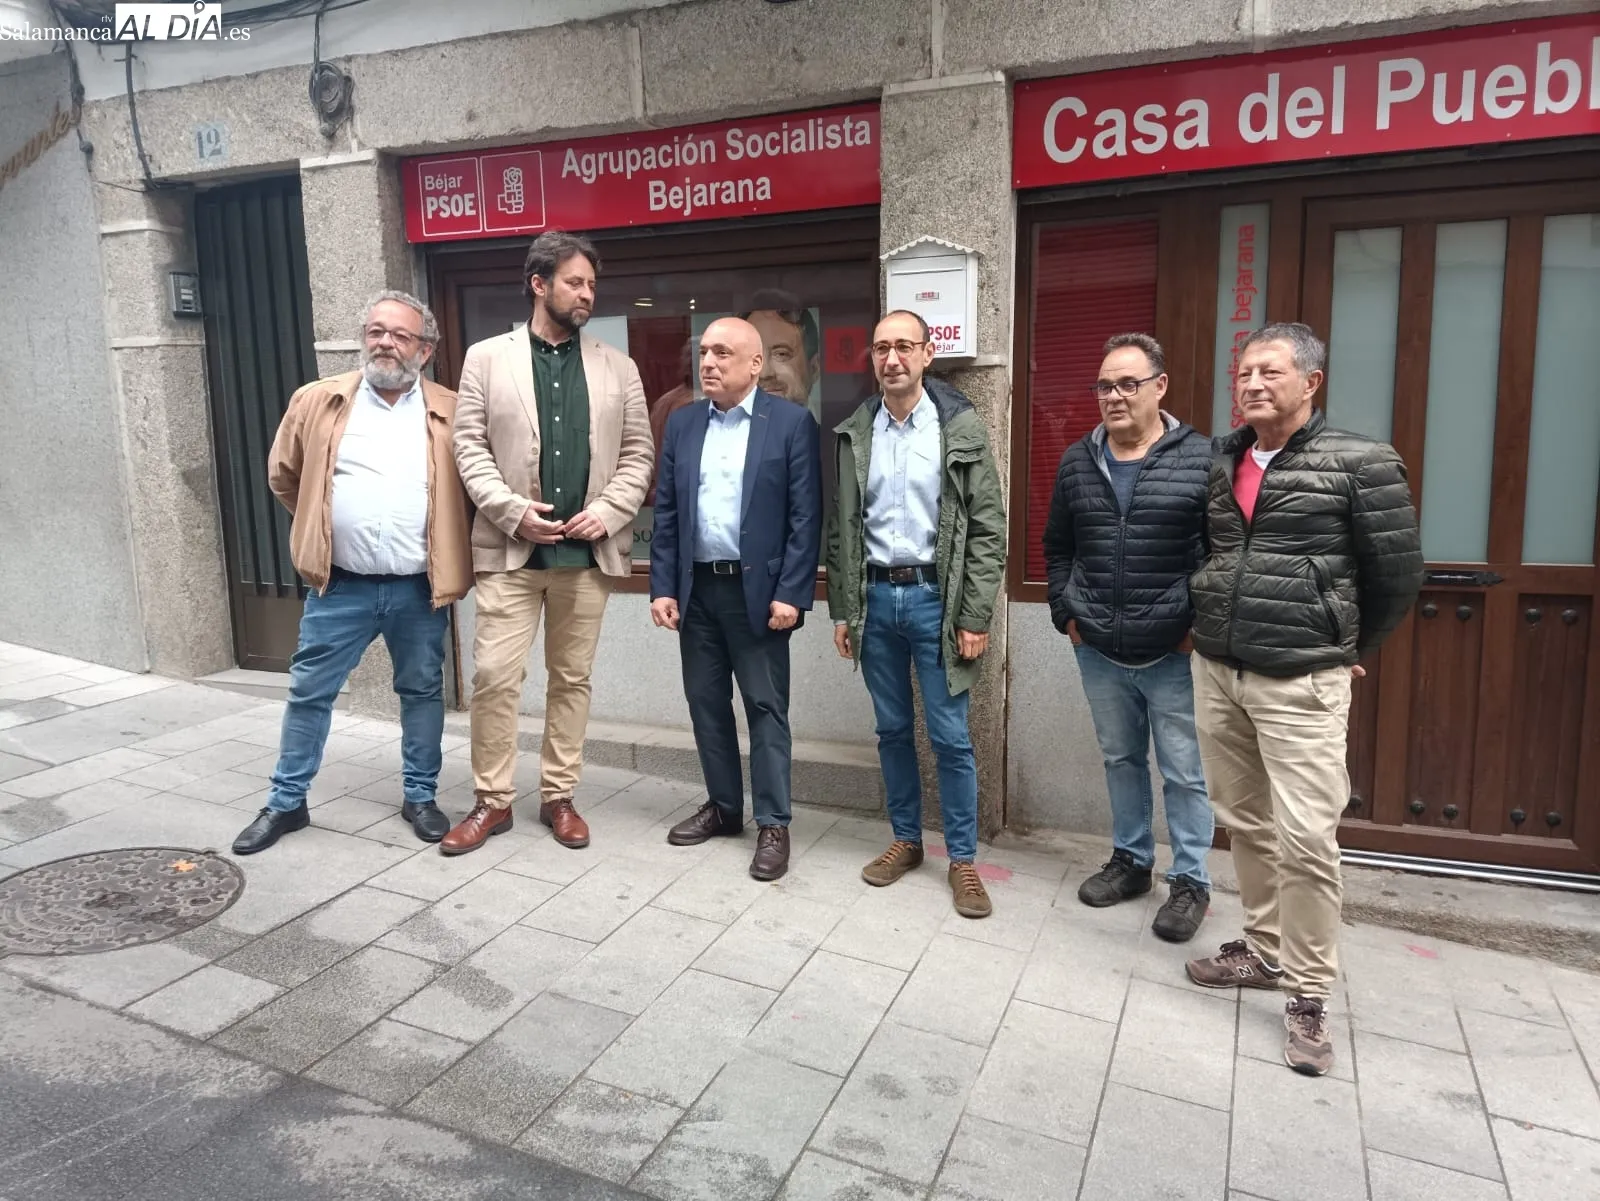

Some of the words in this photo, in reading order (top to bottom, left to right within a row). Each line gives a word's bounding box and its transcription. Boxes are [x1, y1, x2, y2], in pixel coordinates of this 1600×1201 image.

[1043, 96, 1209, 164] Casa
[1238, 65, 1345, 144] del
[197, 128, 222, 159] 12
[561, 132, 716, 184] Agrupación
[726, 115, 872, 161] Socialista
[424, 173, 463, 193] Béjar
[649, 176, 772, 216] Bejarana
[426, 192, 477, 219] PSOE
[1230, 224, 1258, 322] bejarana
[935, 342, 956, 352] éjar
[1237, 964, 1254, 978] N
